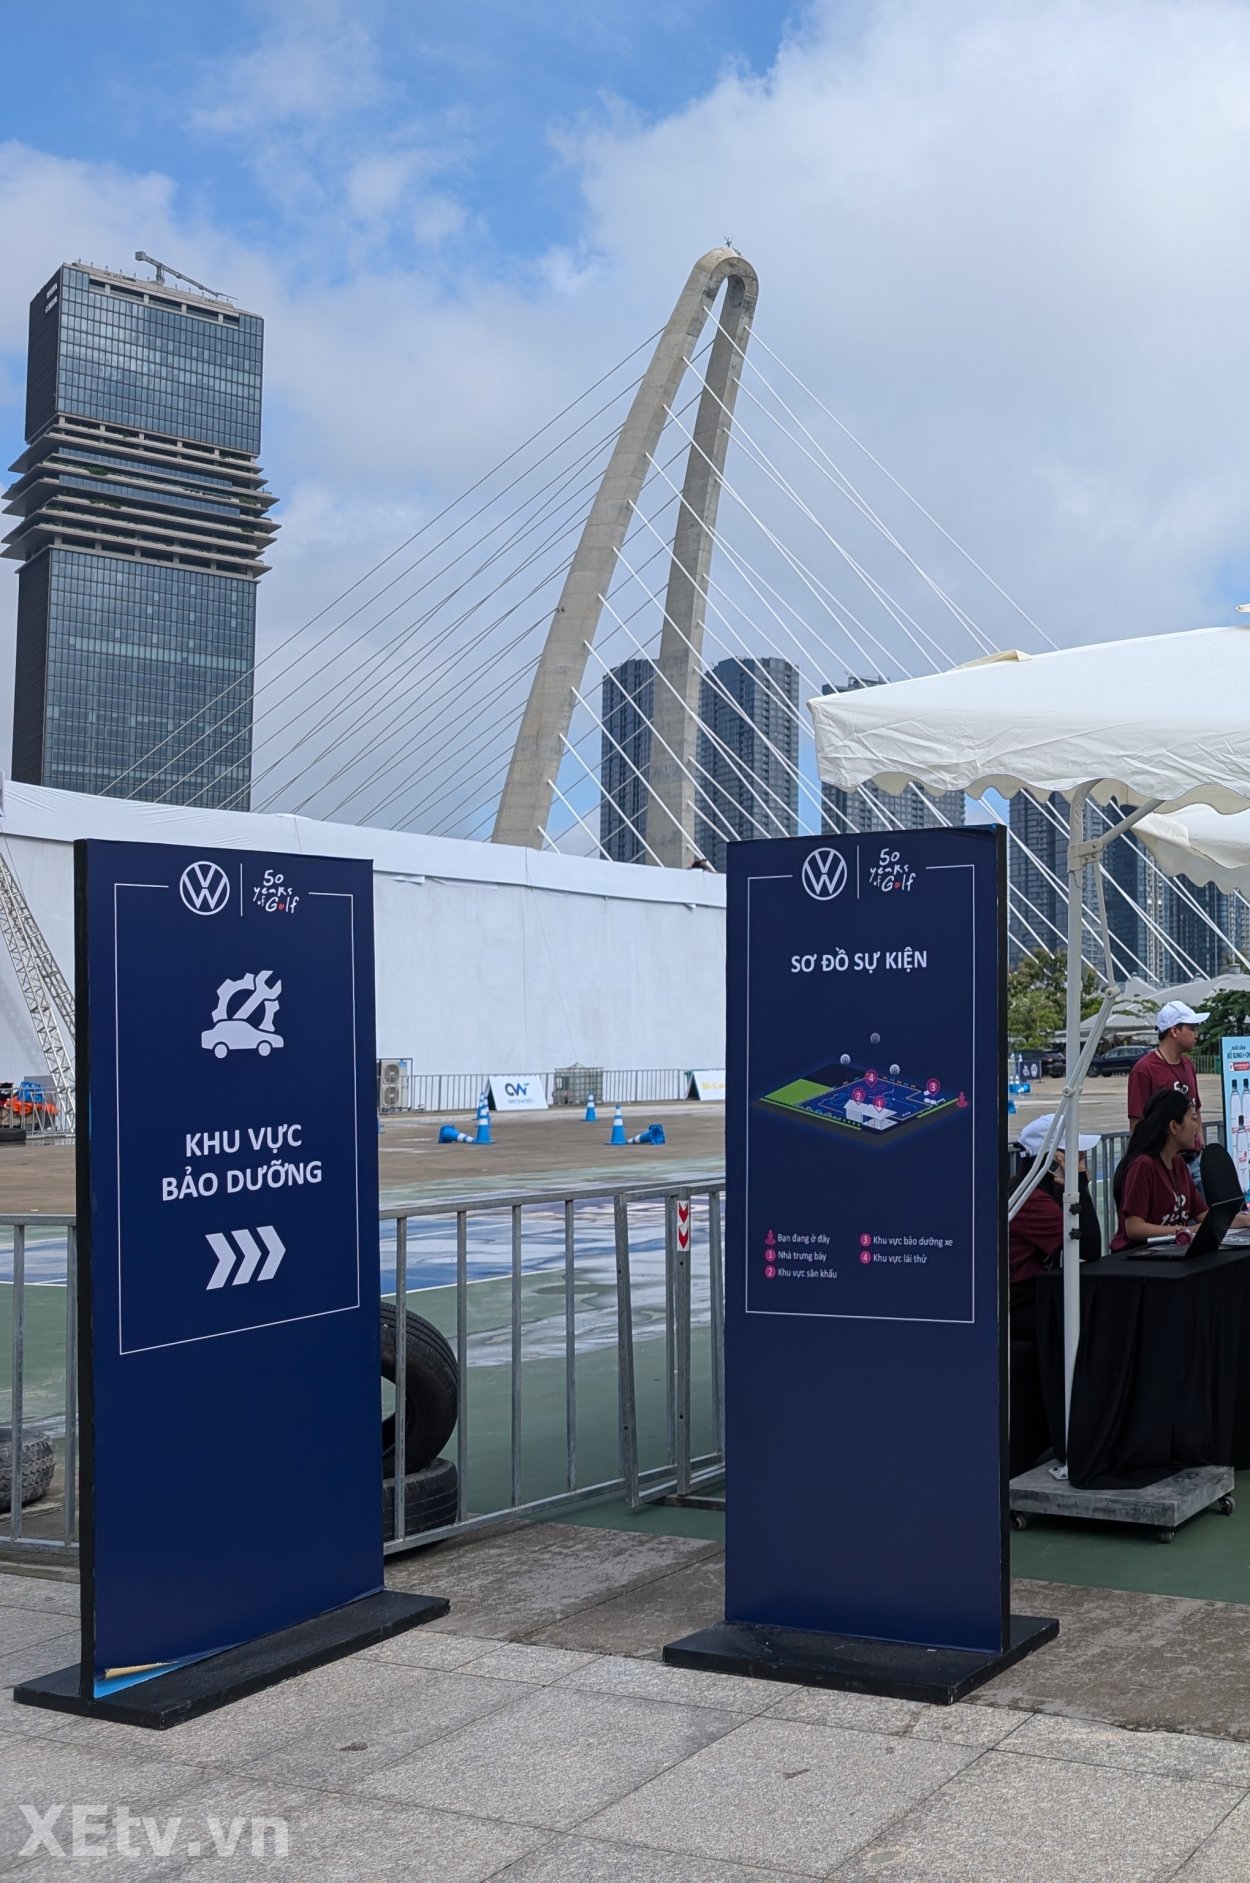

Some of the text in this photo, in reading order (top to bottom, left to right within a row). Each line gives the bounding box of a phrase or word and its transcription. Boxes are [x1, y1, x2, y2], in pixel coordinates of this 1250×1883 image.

[879, 848, 900, 866] 50
[263, 870, 284, 886] 50
[882, 872, 916, 892] Golf
[266, 896, 300, 914] Golf
[791, 947, 928, 974] SƠ ĐỒ SỰ KIỆN
[185, 1124, 302, 1157] KHU VỰC
[162, 1159, 322, 1201] BẢO DƯỠNG
[874, 1236, 887, 1244] Khu
[888, 1238, 902, 1246] vực
[904, 1236, 917, 1246] bảo
[778, 1250, 791, 1260] Nhà
[874, 1254, 887, 1262] Khu
[888, 1255, 902, 1264] vực
[778, 1268, 790, 1277] Khu
[792, 1270, 806, 1278] vực
